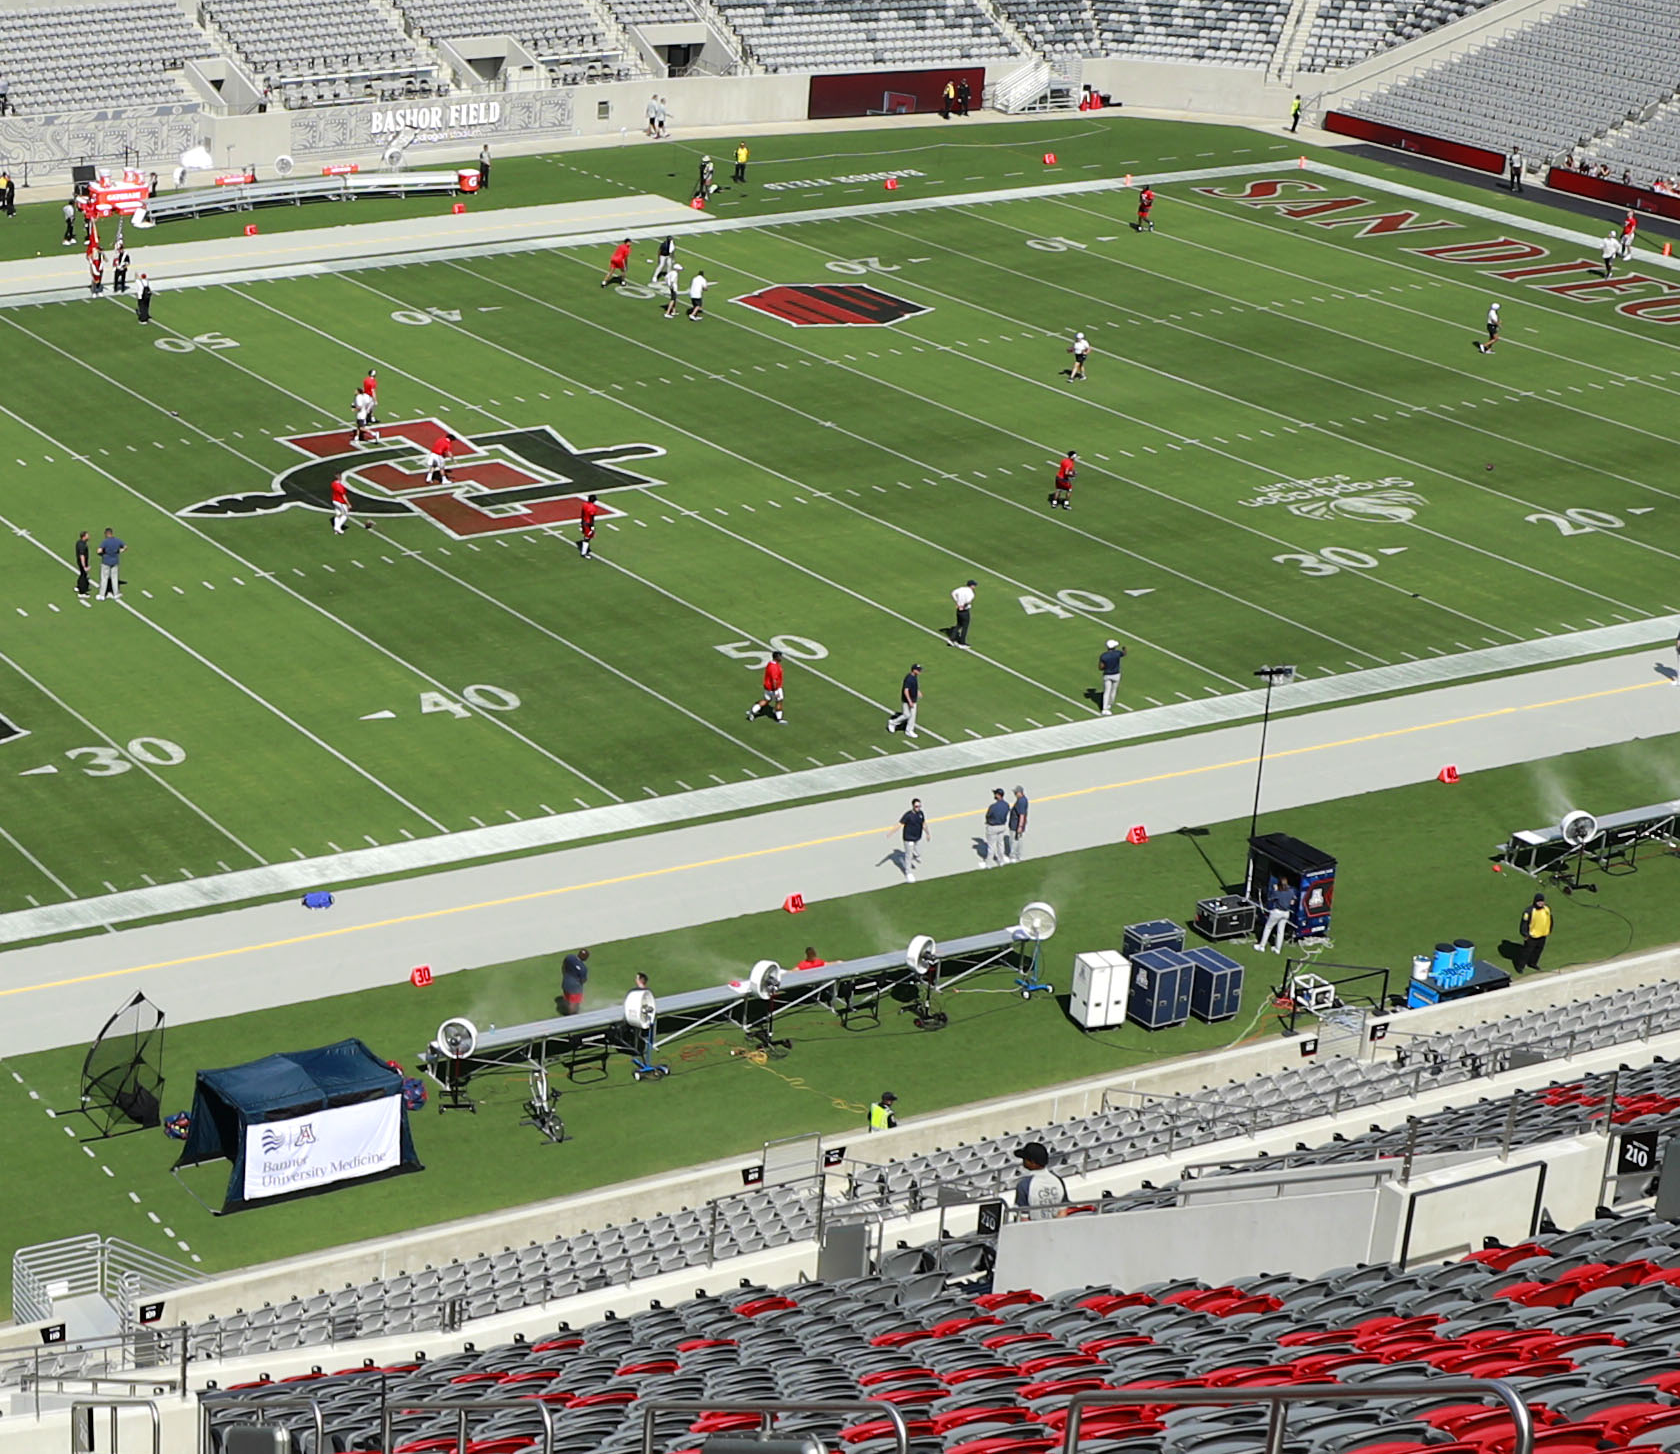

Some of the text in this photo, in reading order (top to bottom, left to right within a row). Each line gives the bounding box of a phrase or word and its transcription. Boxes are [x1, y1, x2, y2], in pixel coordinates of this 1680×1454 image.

[371, 101, 500, 134] BASHOR FIELD
[1192, 178, 1467, 240] SAN
[1023, 235, 1088, 253] 10
[824, 255, 900, 276] 20
[390, 307, 463, 328] 40
[152, 331, 240, 354] 50
[1237, 476, 1414, 509] Snapdragon
[1252, 474, 1352, 494] stadium
[1523, 506, 1627, 537] 20
[1271, 544, 1381, 577] 30
[1017, 587, 1117, 620] 40
[712, 633, 830, 671] 50
[418, 683, 521, 720] 40
[63, 734, 188, 778] 30
[1133, 826, 1147, 840] 50
[790, 894, 804, 909] 40
[417, 968, 432, 983] 30
[263, 1155, 309, 1173] Banner
[1624, 1144, 1648, 1167] 210
[261, 1151, 387, 1188] University Medicine
[1038, 1186, 1057, 1200] CSC
[981, 1211, 997, 1231] 210
